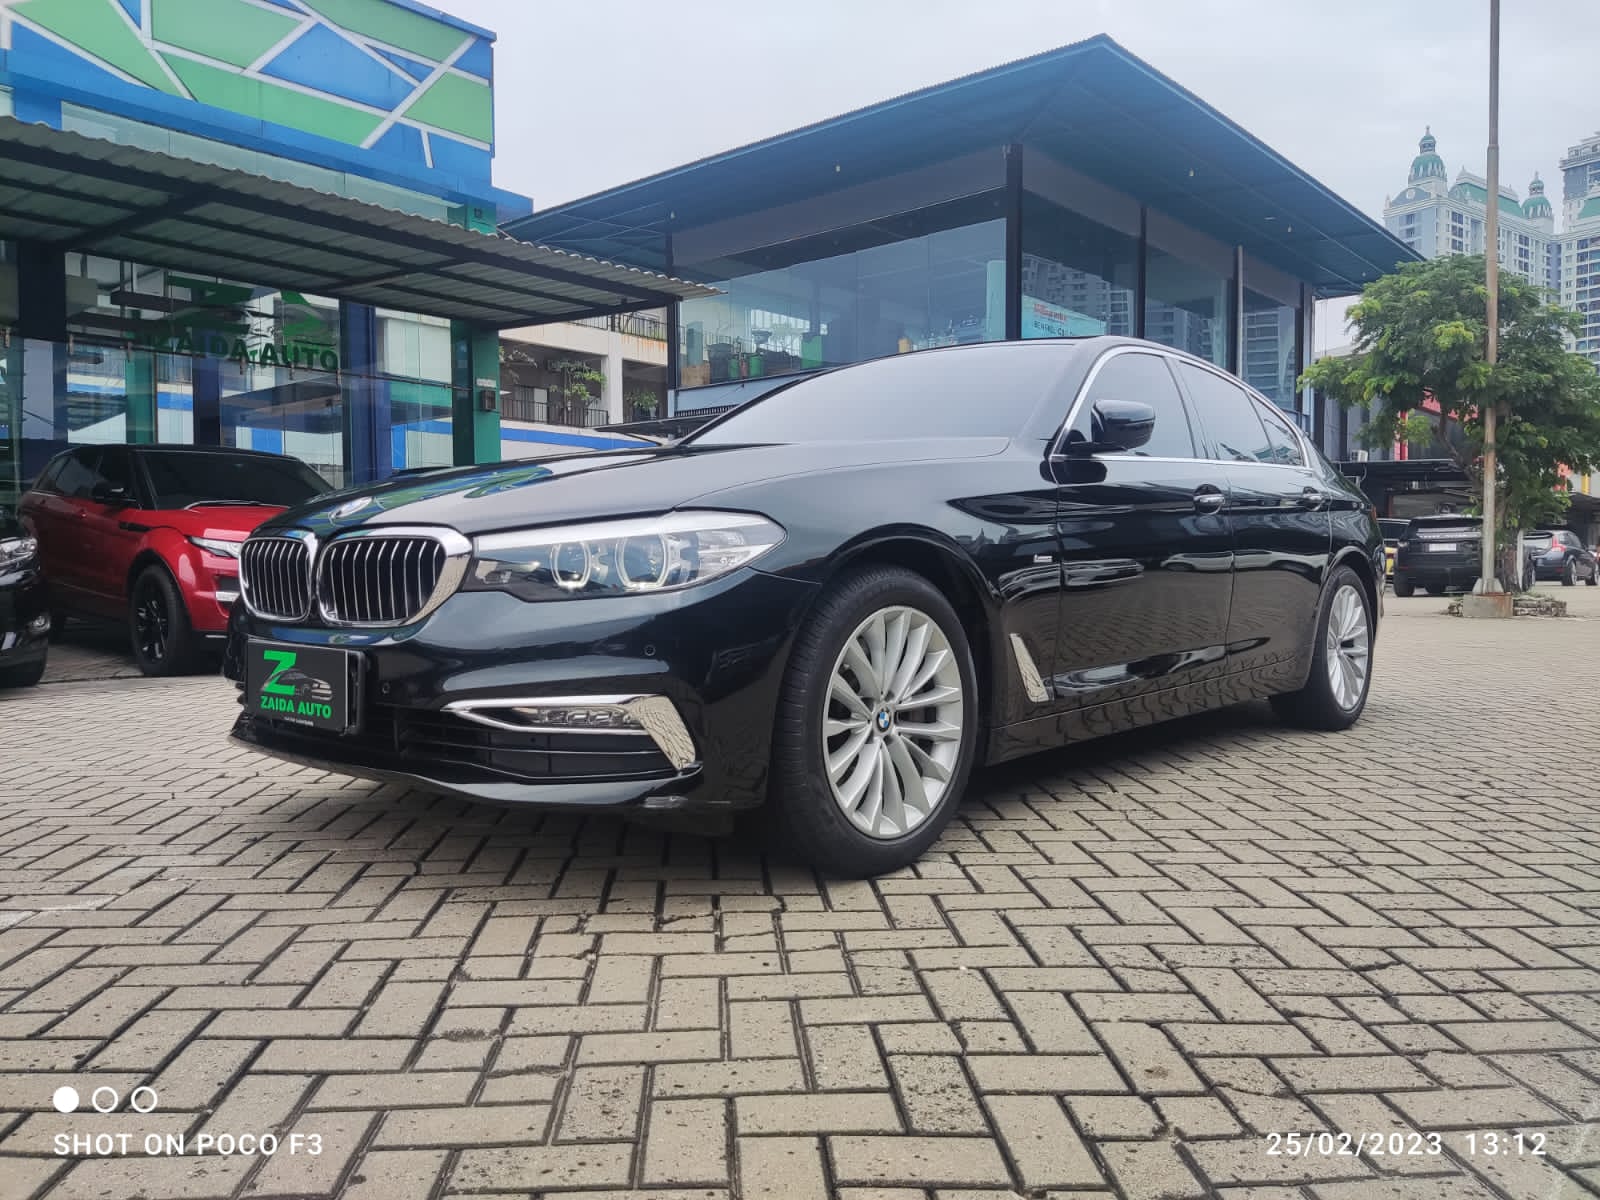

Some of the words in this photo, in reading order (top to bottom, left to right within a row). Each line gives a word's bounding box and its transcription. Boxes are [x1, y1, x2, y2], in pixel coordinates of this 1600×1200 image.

[260, 342, 338, 370] AUTO
[263, 649, 297, 696] Z
[260, 695, 295, 713] ZAIDA
[297, 701, 333, 719] AUTO
